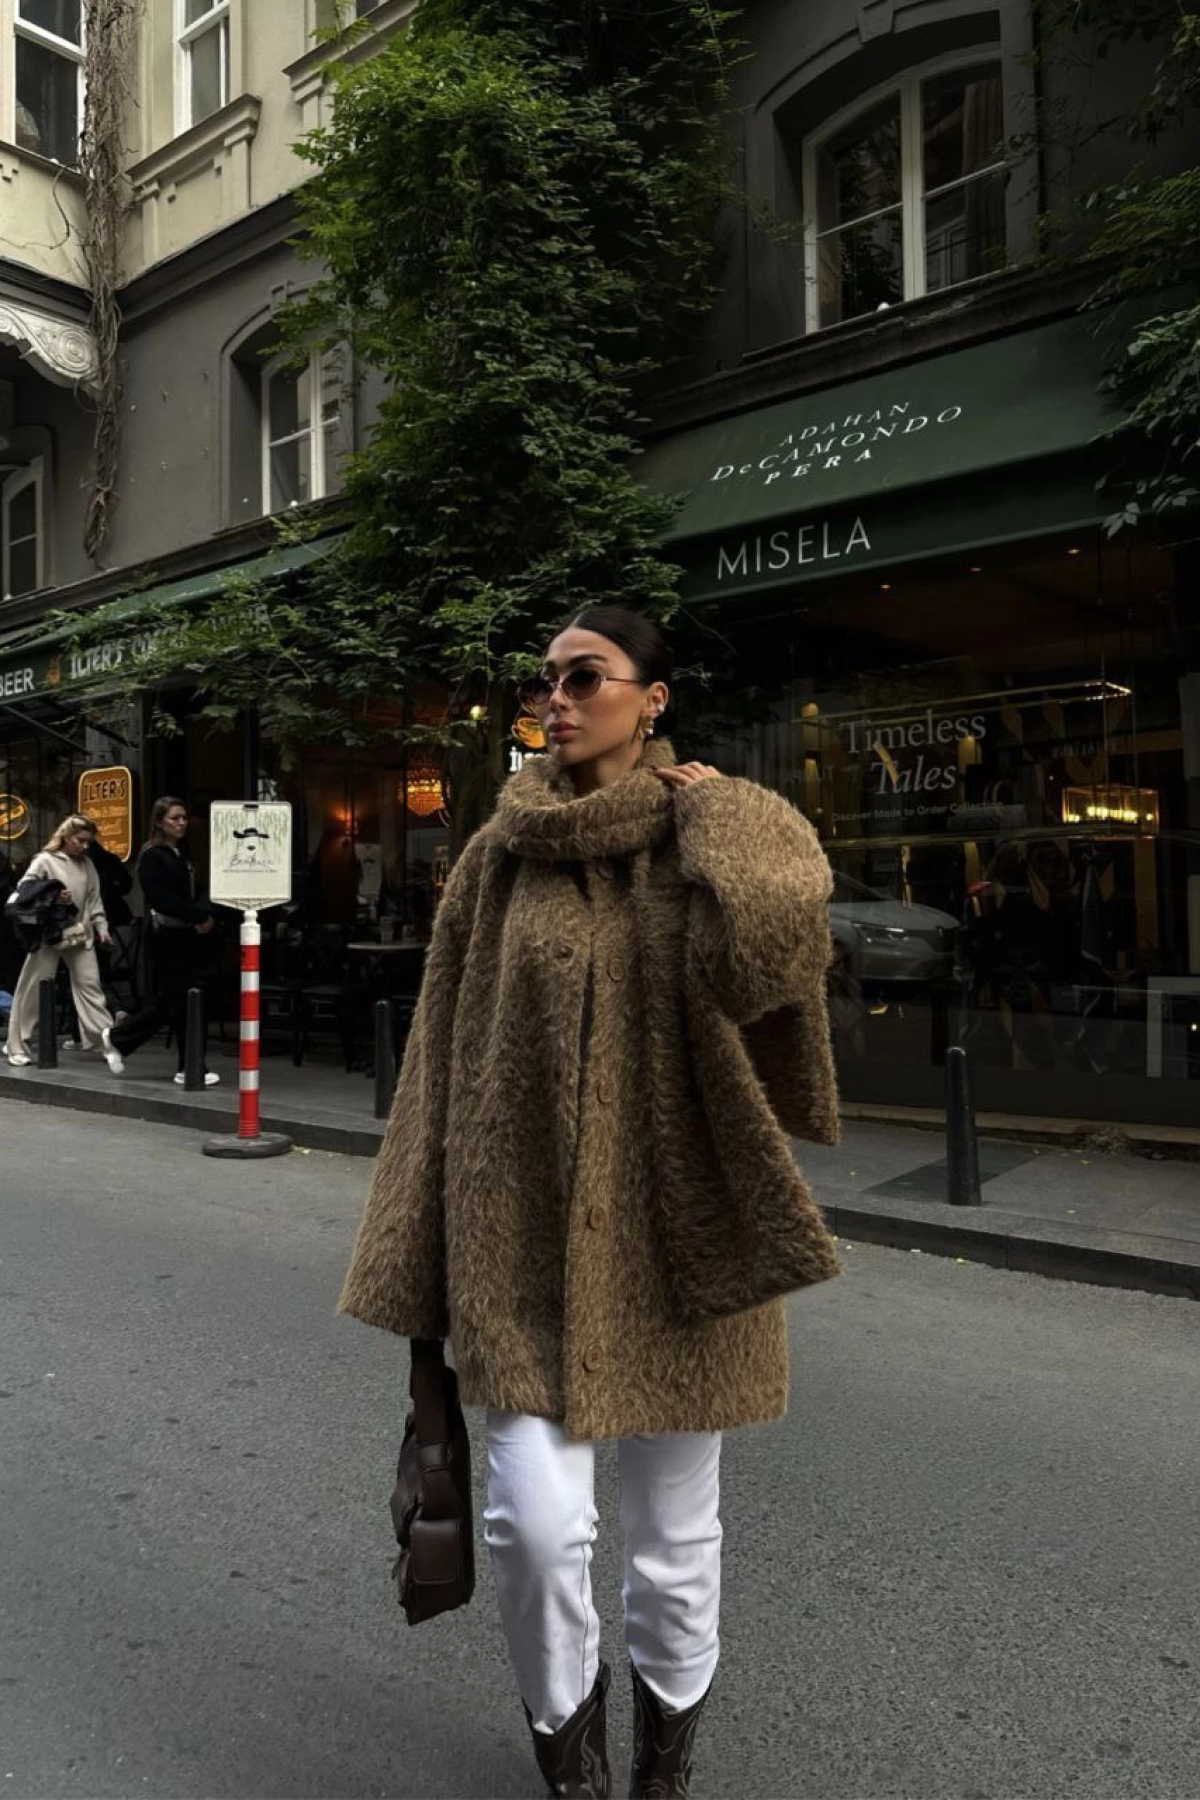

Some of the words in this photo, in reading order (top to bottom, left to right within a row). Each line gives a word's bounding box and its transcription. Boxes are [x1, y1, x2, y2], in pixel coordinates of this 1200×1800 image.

[778, 401, 912, 447] ADAHAN
[763, 448, 873, 486] PERA
[716, 515, 872, 582] MISELA
[840, 708, 987, 755] Timeless
[869, 754, 958, 795] Tales
[916, 805, 949, 816] Order
